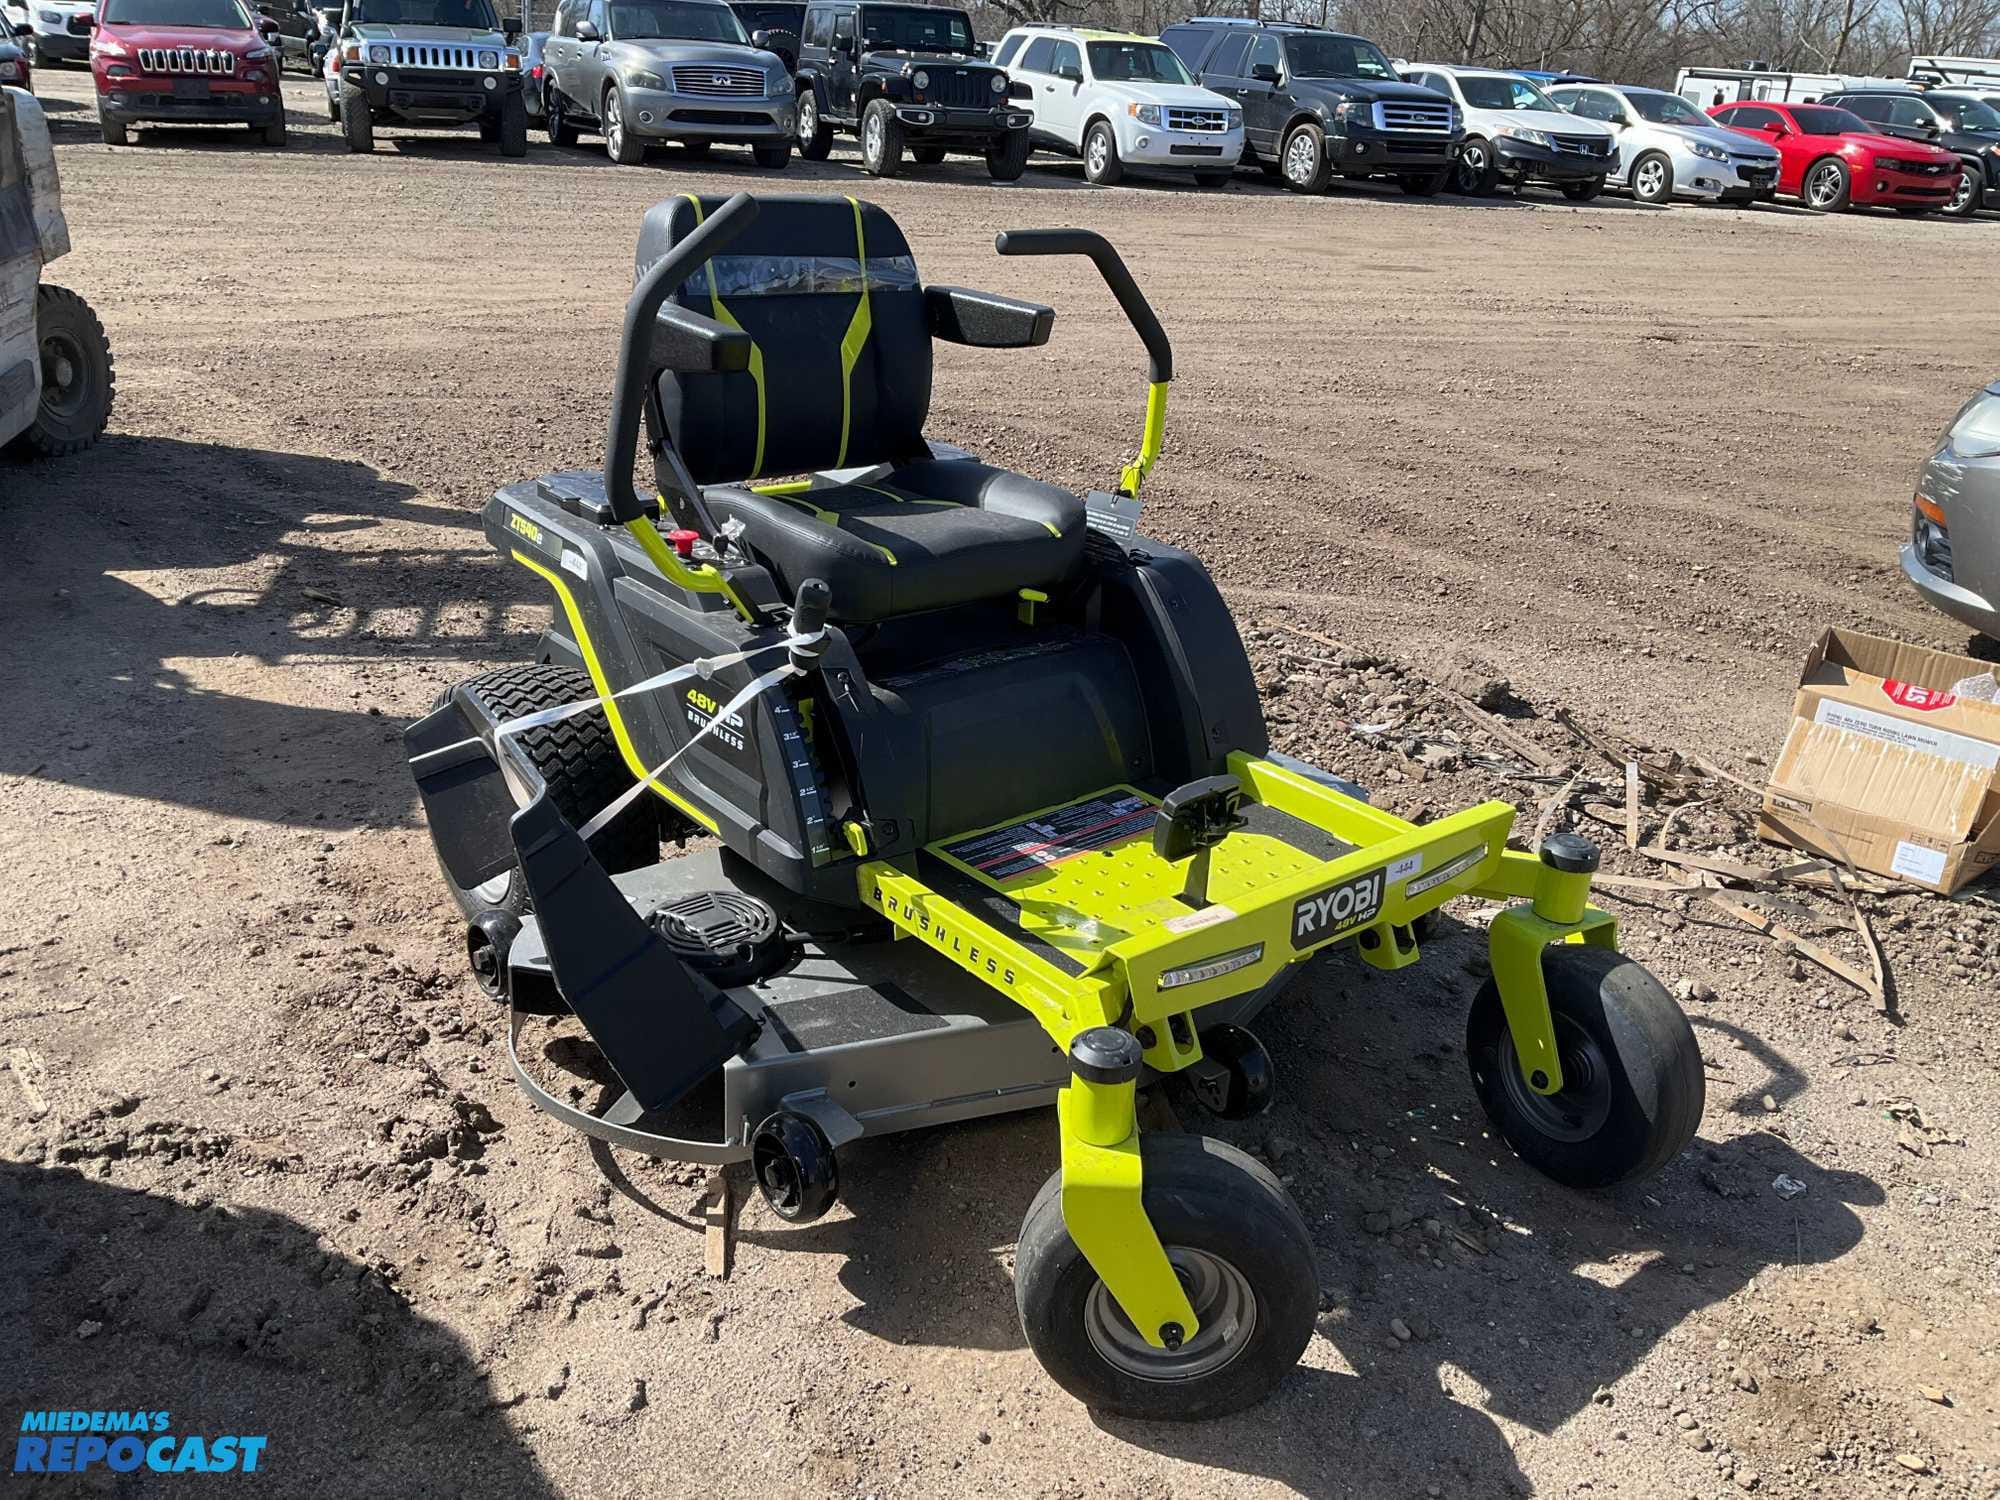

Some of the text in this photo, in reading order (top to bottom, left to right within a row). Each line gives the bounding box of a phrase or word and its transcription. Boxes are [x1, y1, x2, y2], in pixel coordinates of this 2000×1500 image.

[687, 689, 717, 714] 48V
[1297, 874, 1380, 937] RYOBI
[1334, 907, 1377, 931] 48V HP
[873, 886, 1016, 985] BRUSHLESS
